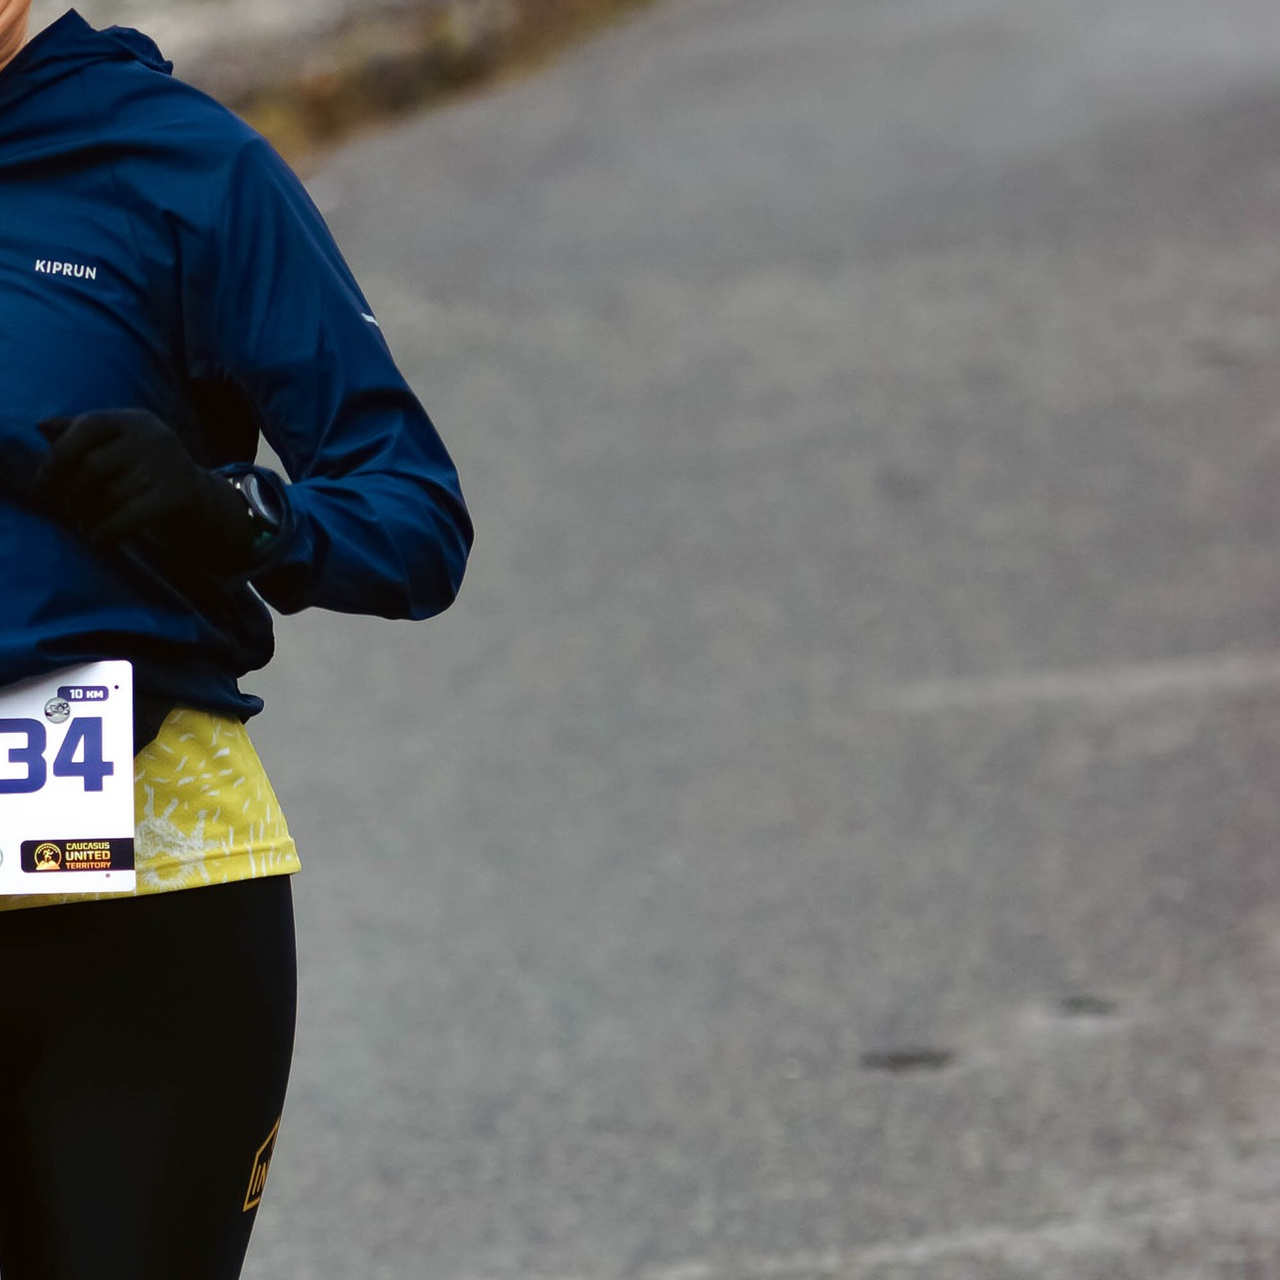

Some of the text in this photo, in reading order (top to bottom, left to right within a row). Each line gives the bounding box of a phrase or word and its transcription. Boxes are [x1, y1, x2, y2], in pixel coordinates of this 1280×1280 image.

[35, 259, 97, 280] KIPRUN
[69, 689, 83, 699] 10
[66, 842, 110, 850] CAUCASUS
[65, 850, 111, 861] UNITED
[65, 861, 111, 869] TERRITORY
